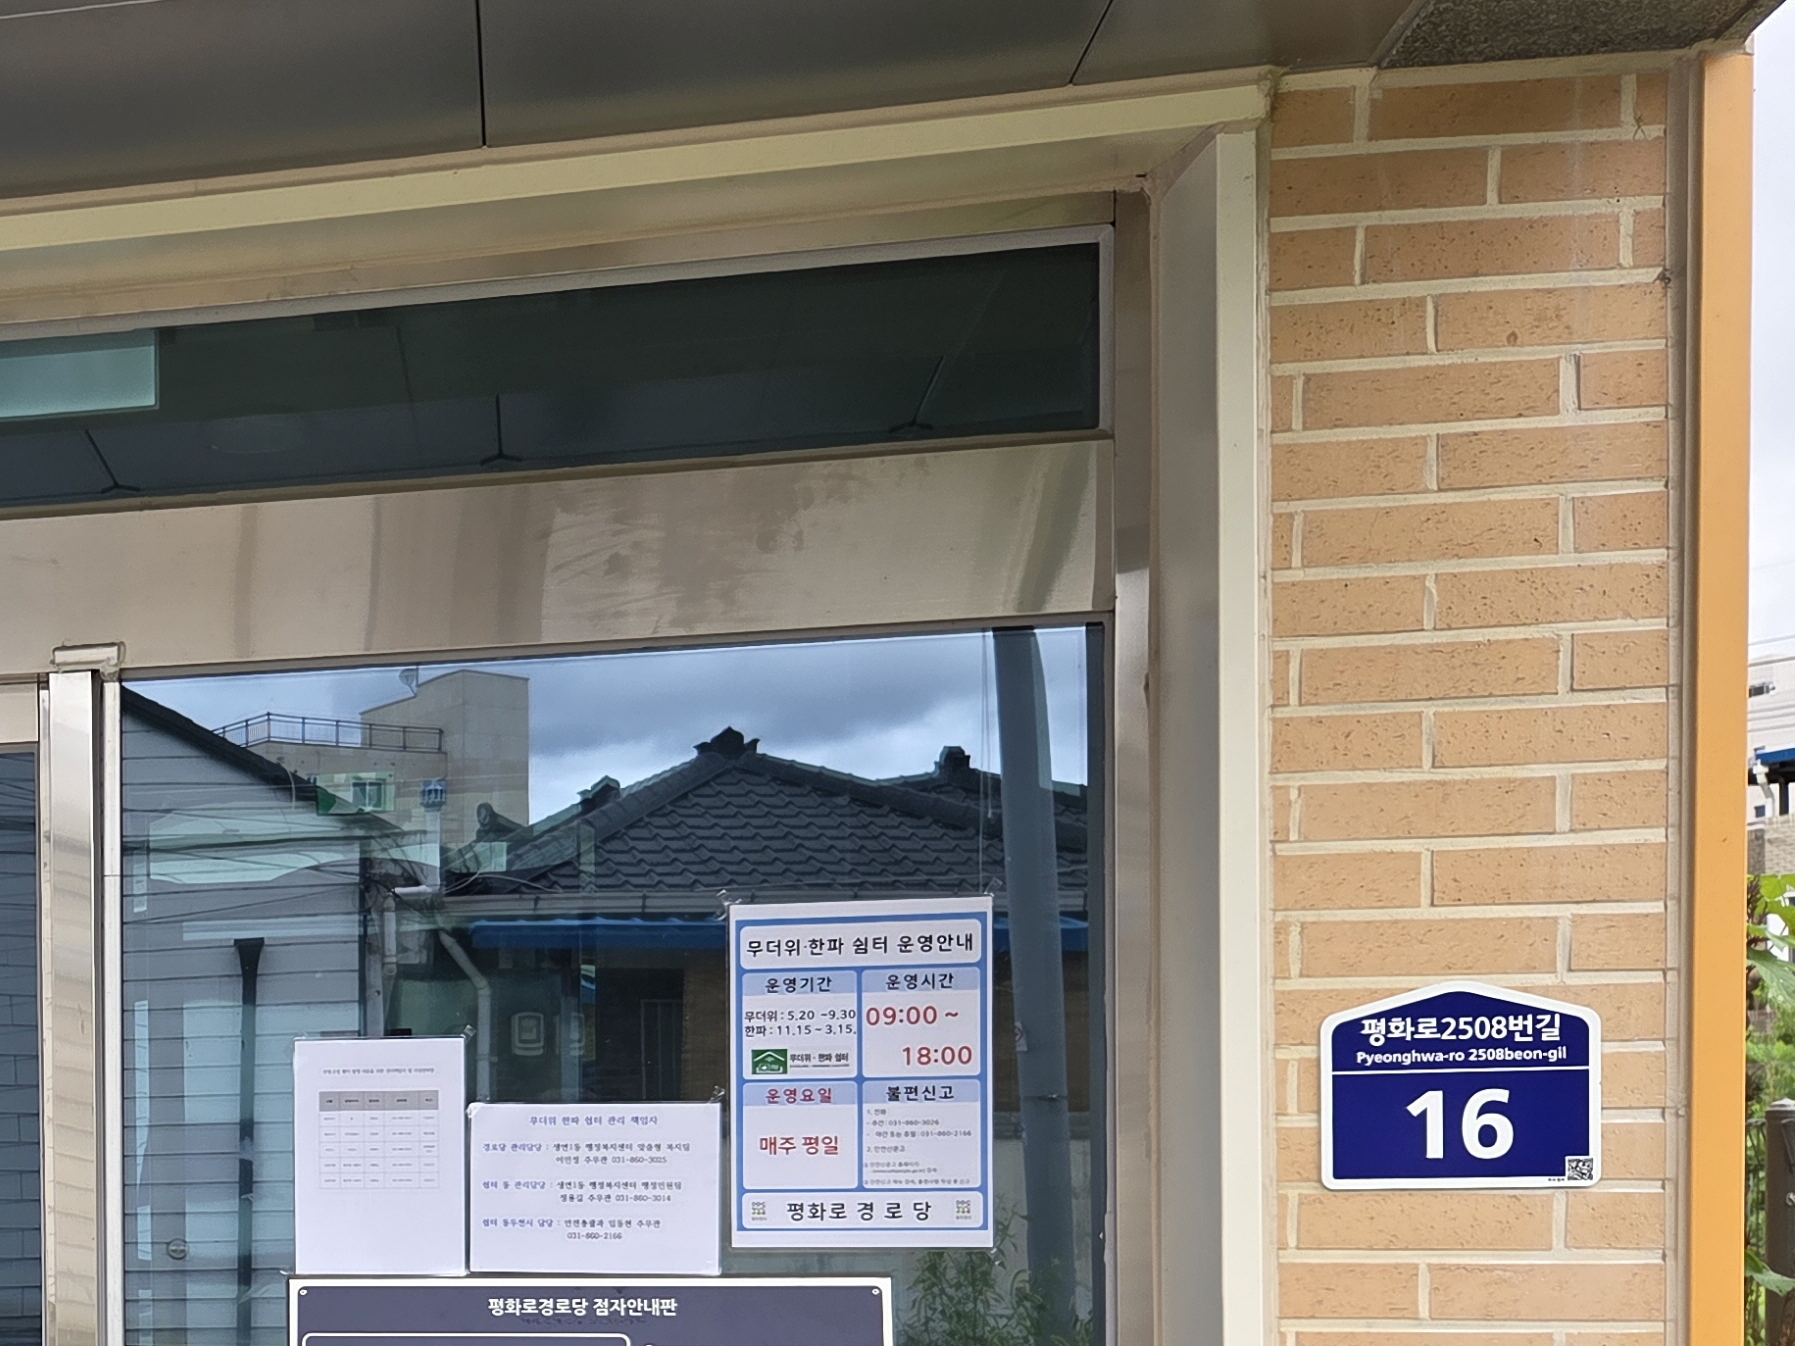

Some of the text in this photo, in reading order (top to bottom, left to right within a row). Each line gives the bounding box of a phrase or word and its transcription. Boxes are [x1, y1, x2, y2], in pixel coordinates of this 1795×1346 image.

[852, 935, 888, 955] 쉼터
[897, 933, 973, 953] 운영안내
[765, 976, 832, 994] 운영기간
[885, 973, 954, 990] 운영시간
[787, 1010, 815, 1021] 5.20
[865, 1006, 937, 1026] 09:00
[744, 1026, 767, 1038] 한파
[777, 1025, 811, 1036] 11.15
[1360, 1013, 1561, 1047] 평화로2508번길
[902, 1046, 973, 1066] 18:00
[1356, 1046, 1567, 1066] Pyeonghwa-ro 2508beon-gil
[765, 1087, 832, 1104] 운영요일
[885, 1085, 955, 1101] 불편신고
[1406, 1088, 1514, 1159] 16
[759, 1135, 839, 1155] 매주 평일
[487, 1298, 678, 1317] 평화로경로당 점자안내판
